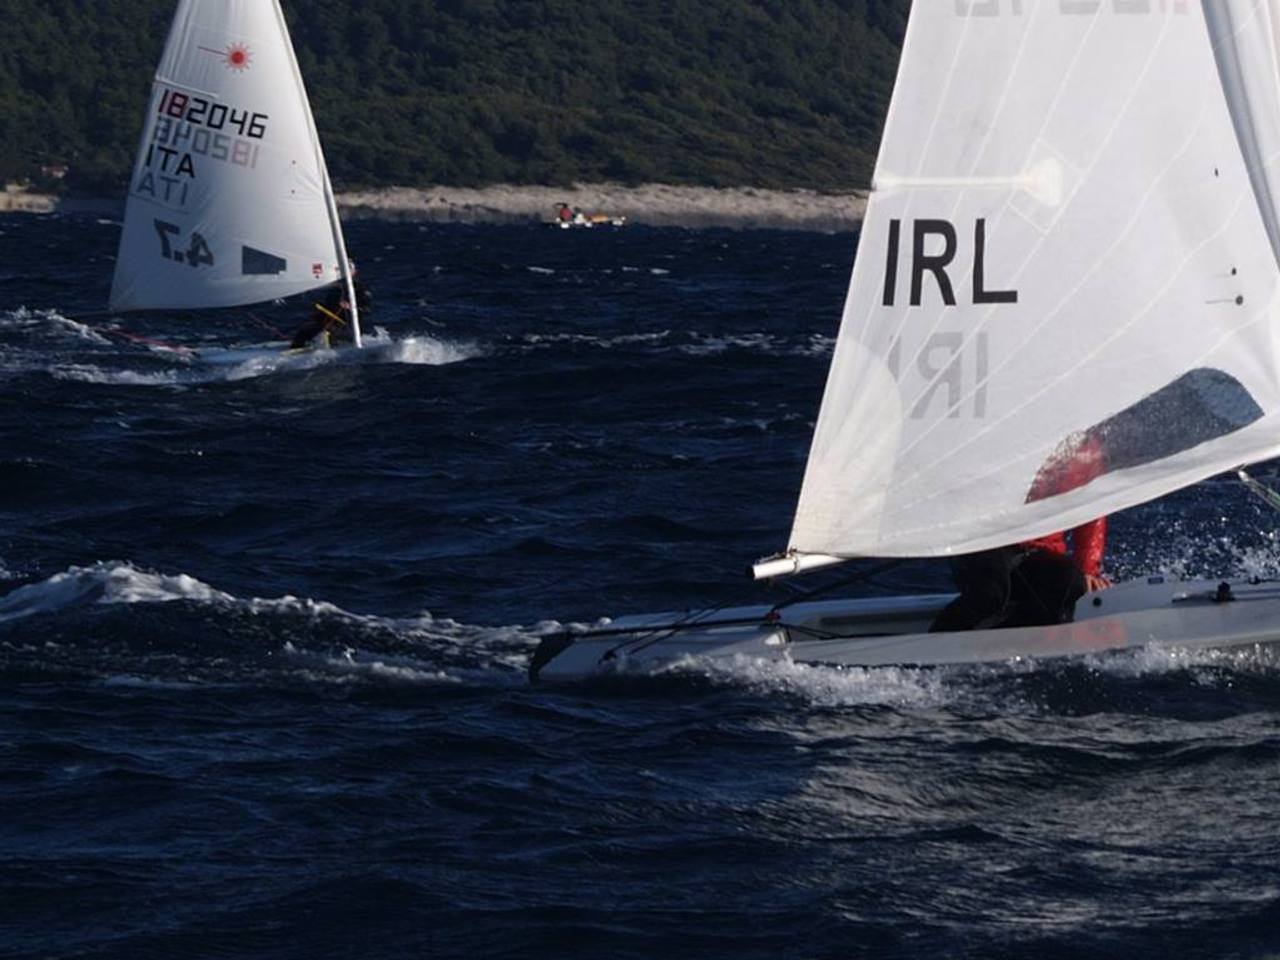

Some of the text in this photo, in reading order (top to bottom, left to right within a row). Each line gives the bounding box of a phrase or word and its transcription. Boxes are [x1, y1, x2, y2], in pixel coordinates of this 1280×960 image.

[158, 89, 269, 139] 182046
[145, 143, 196, 179] ITA
[882, 218, 1018, 307] IRL
